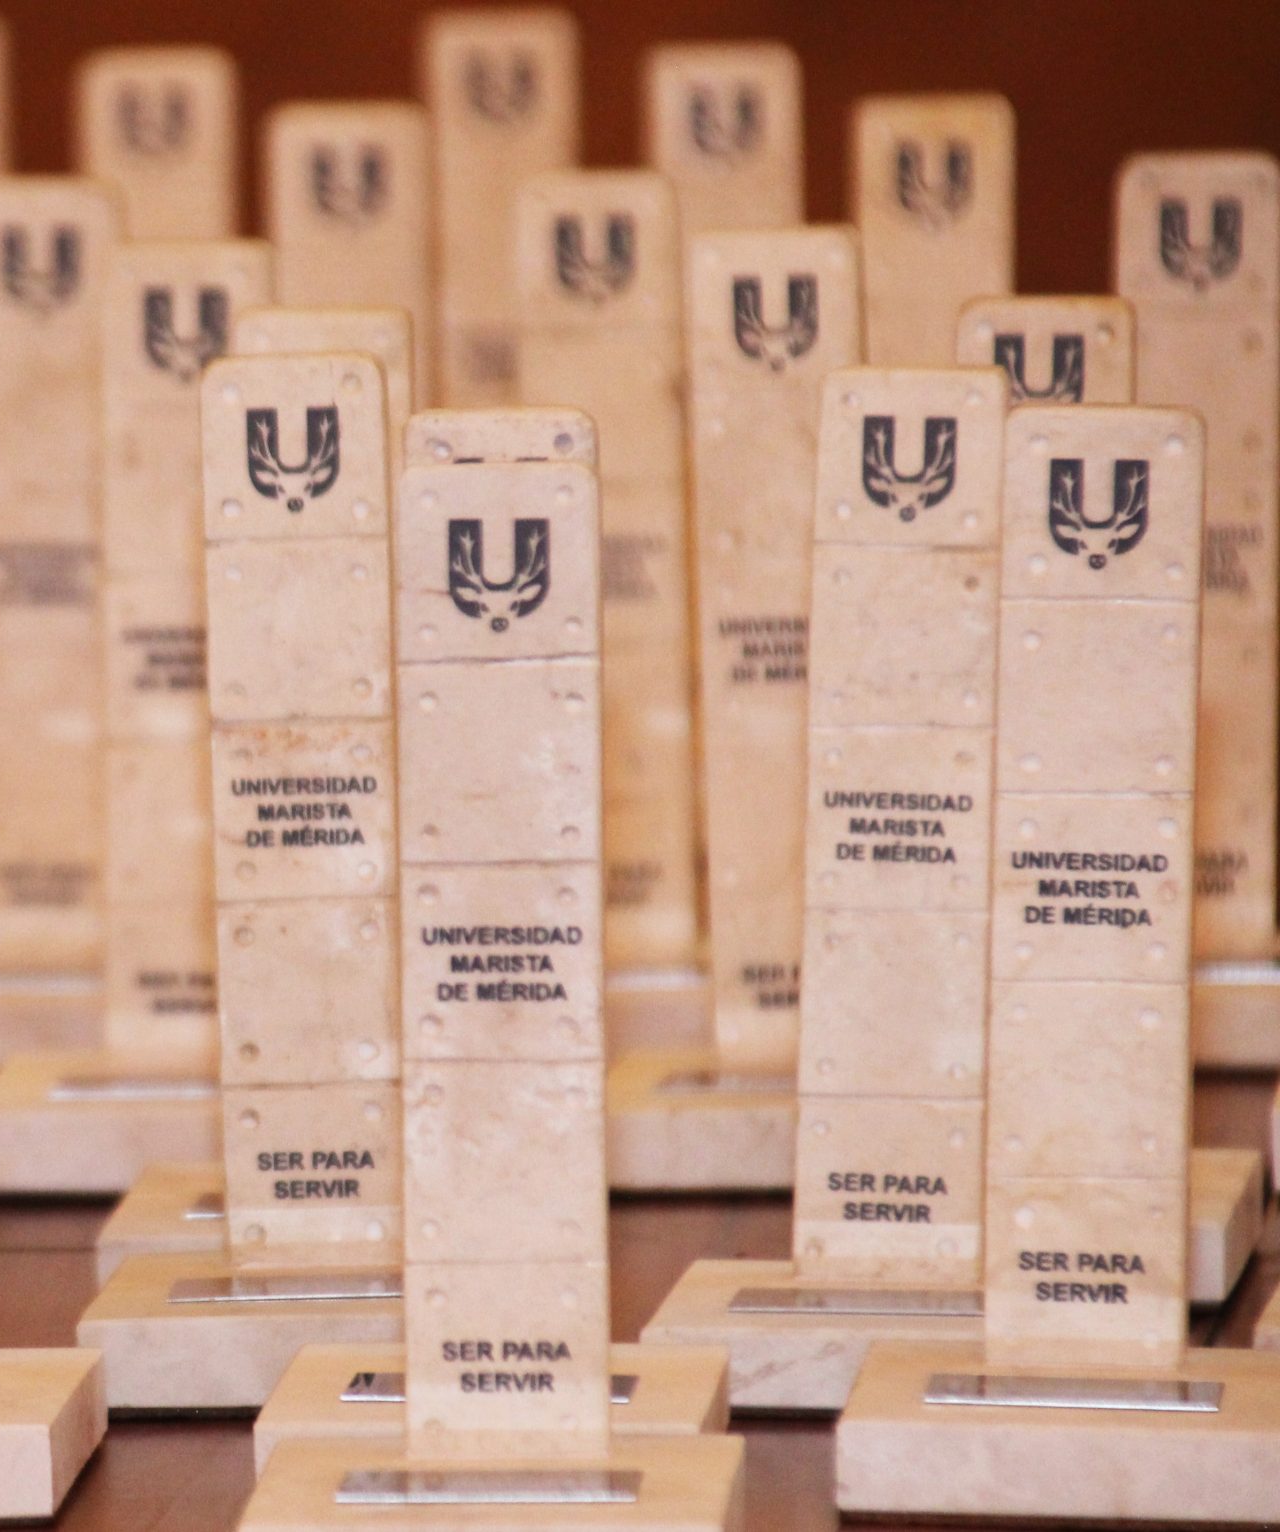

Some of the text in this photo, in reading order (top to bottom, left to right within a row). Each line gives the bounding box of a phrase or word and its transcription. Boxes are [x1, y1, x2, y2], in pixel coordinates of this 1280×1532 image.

[231, 776, 377, 797] UNIVERSIDAD
[257, 802, 352, 822] MARISTA
[823, 790, 973, 813] UNIVERSIDAD
[246, 824, 364, 848] DE MÉRIDA
[848, 817, 945, 838] MARISTA
[836, 841, 956, 864] DE MÉRIDA
[1011, 851, 1168, 873] UNIVERSIDAD
[1037, 879, 1140, 899] MARISTA
[1024, 903, 1152, 927] DE MÉRIDA
[421, 925, 583, 947] UNIVERSIDAD
[449, 954, 554, 974] MARISTA
[437, 979, 567, 1003] DE MÉRIDA
[257, 1150, 375, 1172] SER PARA
[273, 1178, 360, 1200] SERVIR
[828, 1172, 948, 1196] SER PARA
[843, 1201, 931, 1223] SERVIR
[1018, 1251, 1146, 1275] SER PARA
[1035, 1281, 1128, 1304] SERVIR
[441, 1340, 571, 1362] SER PARA
[459, 1371, 554, 1392] SERVIR
